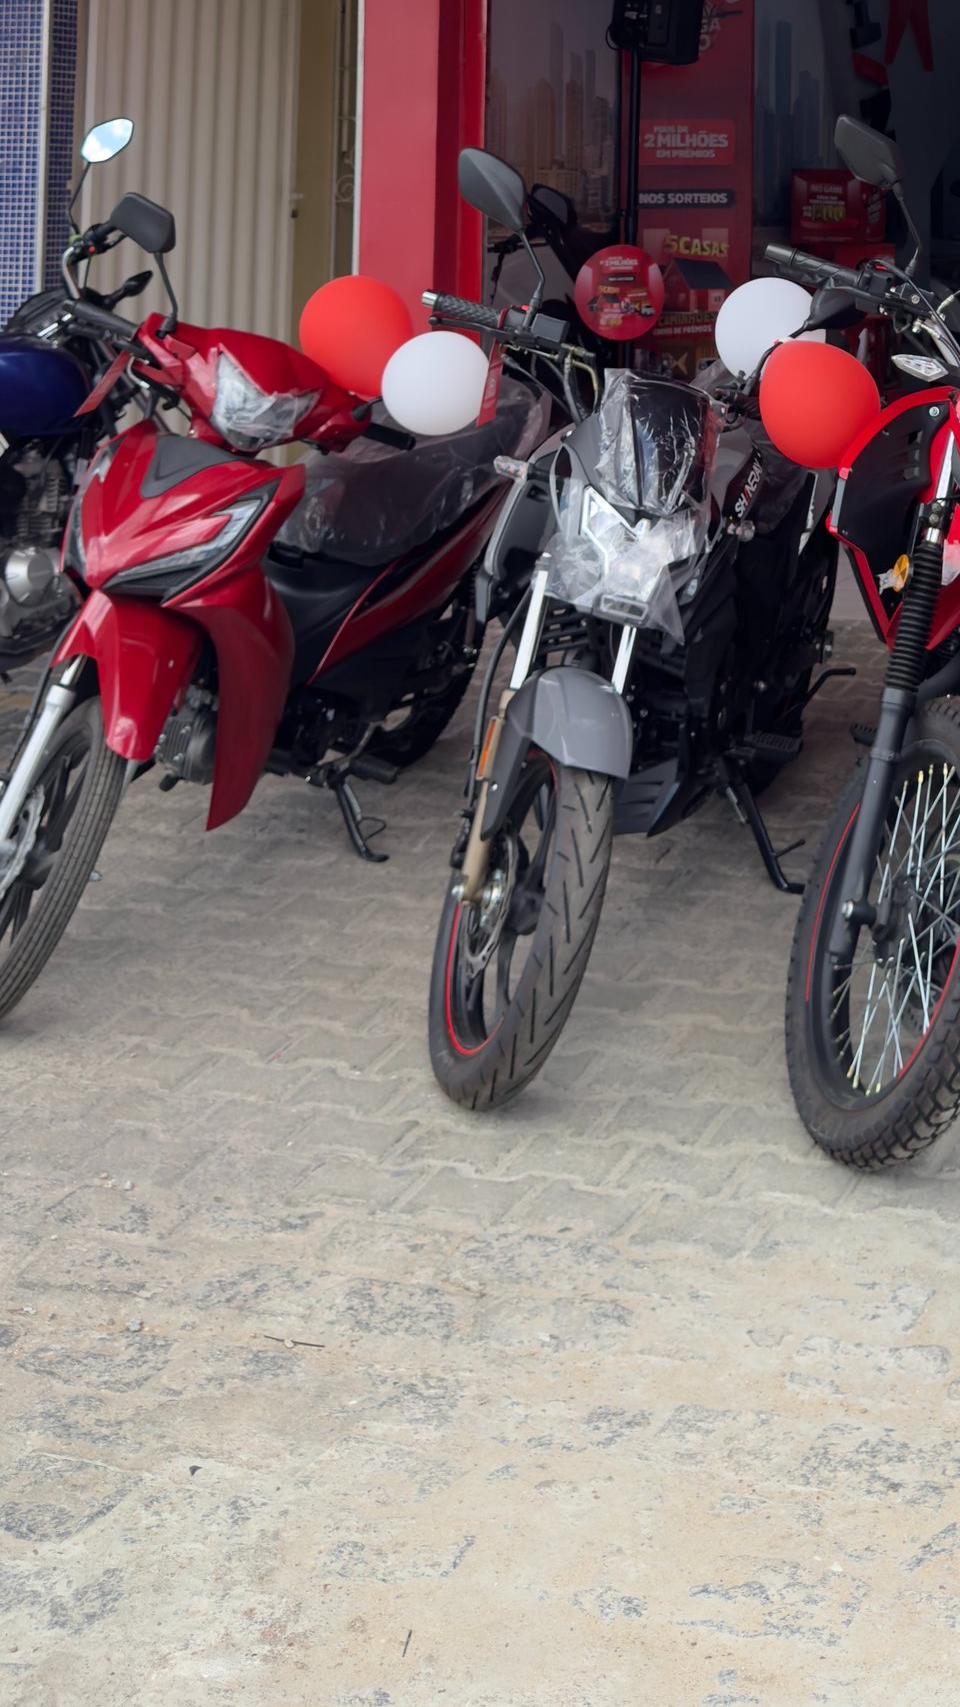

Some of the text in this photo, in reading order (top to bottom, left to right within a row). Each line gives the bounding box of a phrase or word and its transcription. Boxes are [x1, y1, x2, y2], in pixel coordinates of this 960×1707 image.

[643, 130, 729, 148] 2 MILHÕES
[638, 192, 728, 204] NOS SORTEIOS
